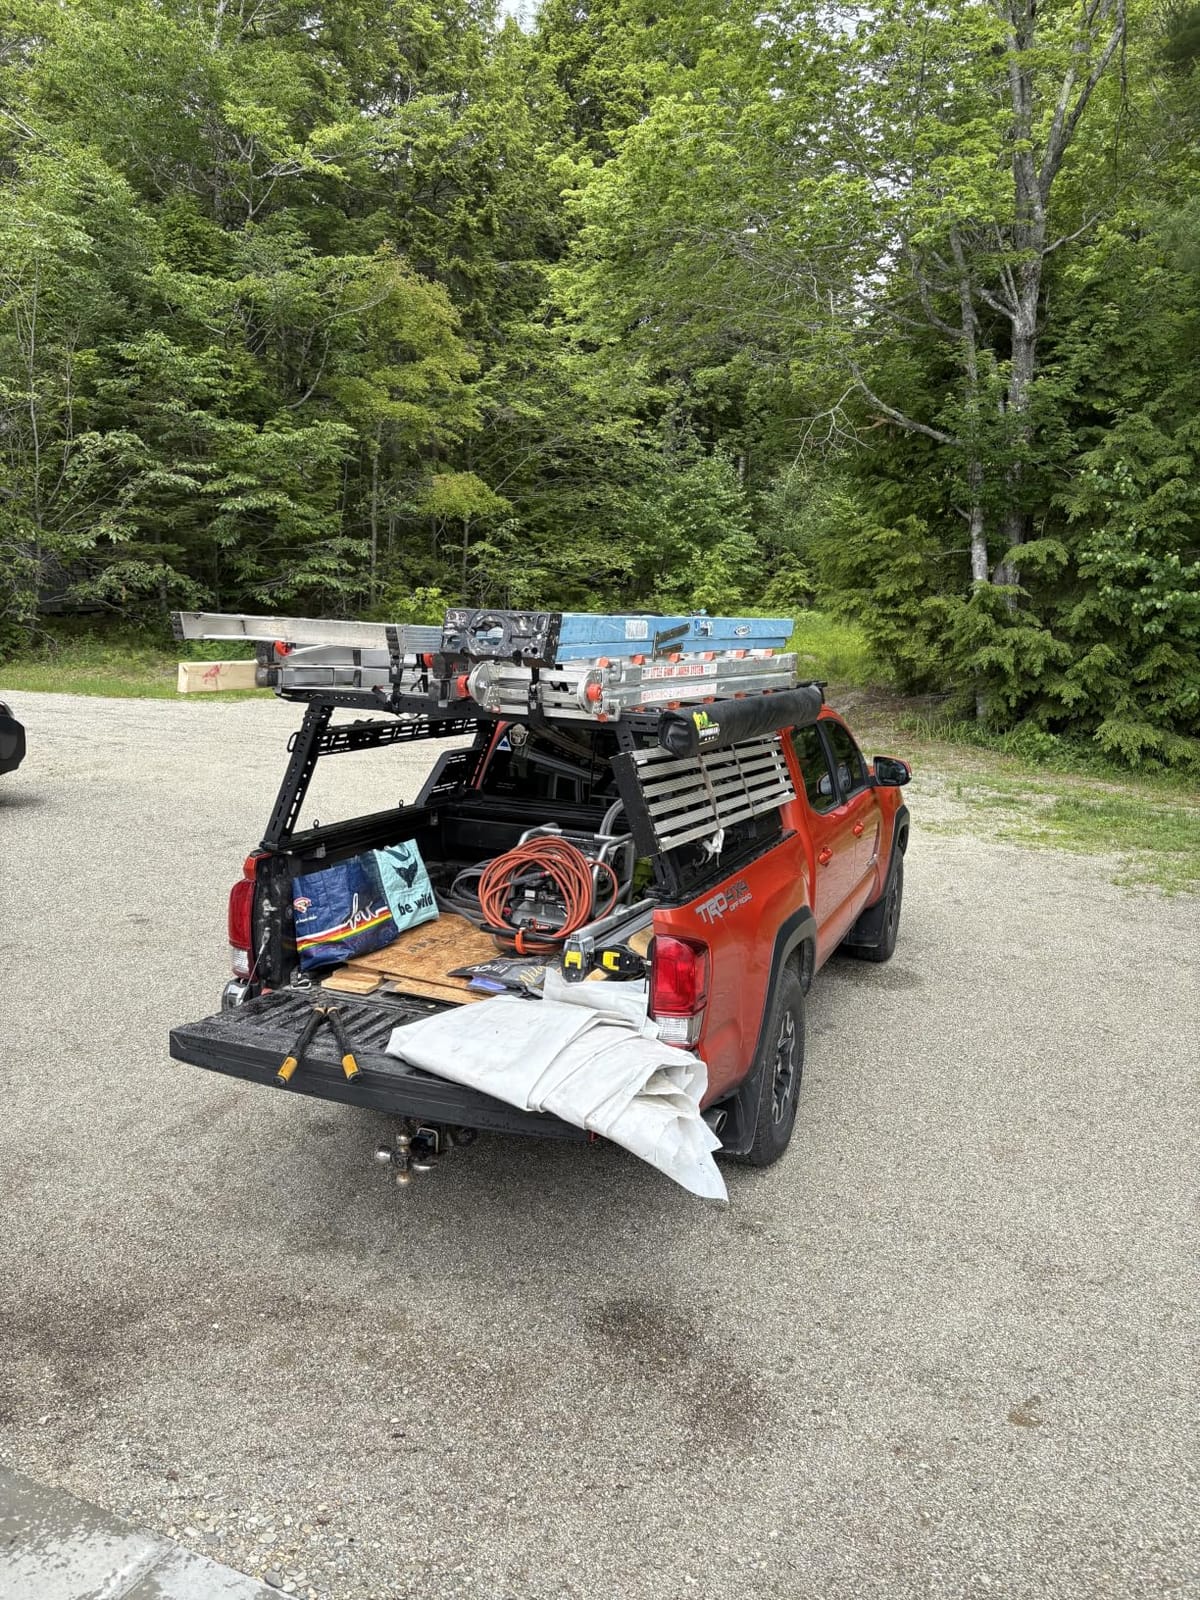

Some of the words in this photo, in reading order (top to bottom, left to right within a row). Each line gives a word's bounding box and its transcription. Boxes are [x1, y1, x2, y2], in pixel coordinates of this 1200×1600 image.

[398, 902, 413, 916] be
[414, 892, 434, 909] wild
[695, 892, 728, 924] TRD
